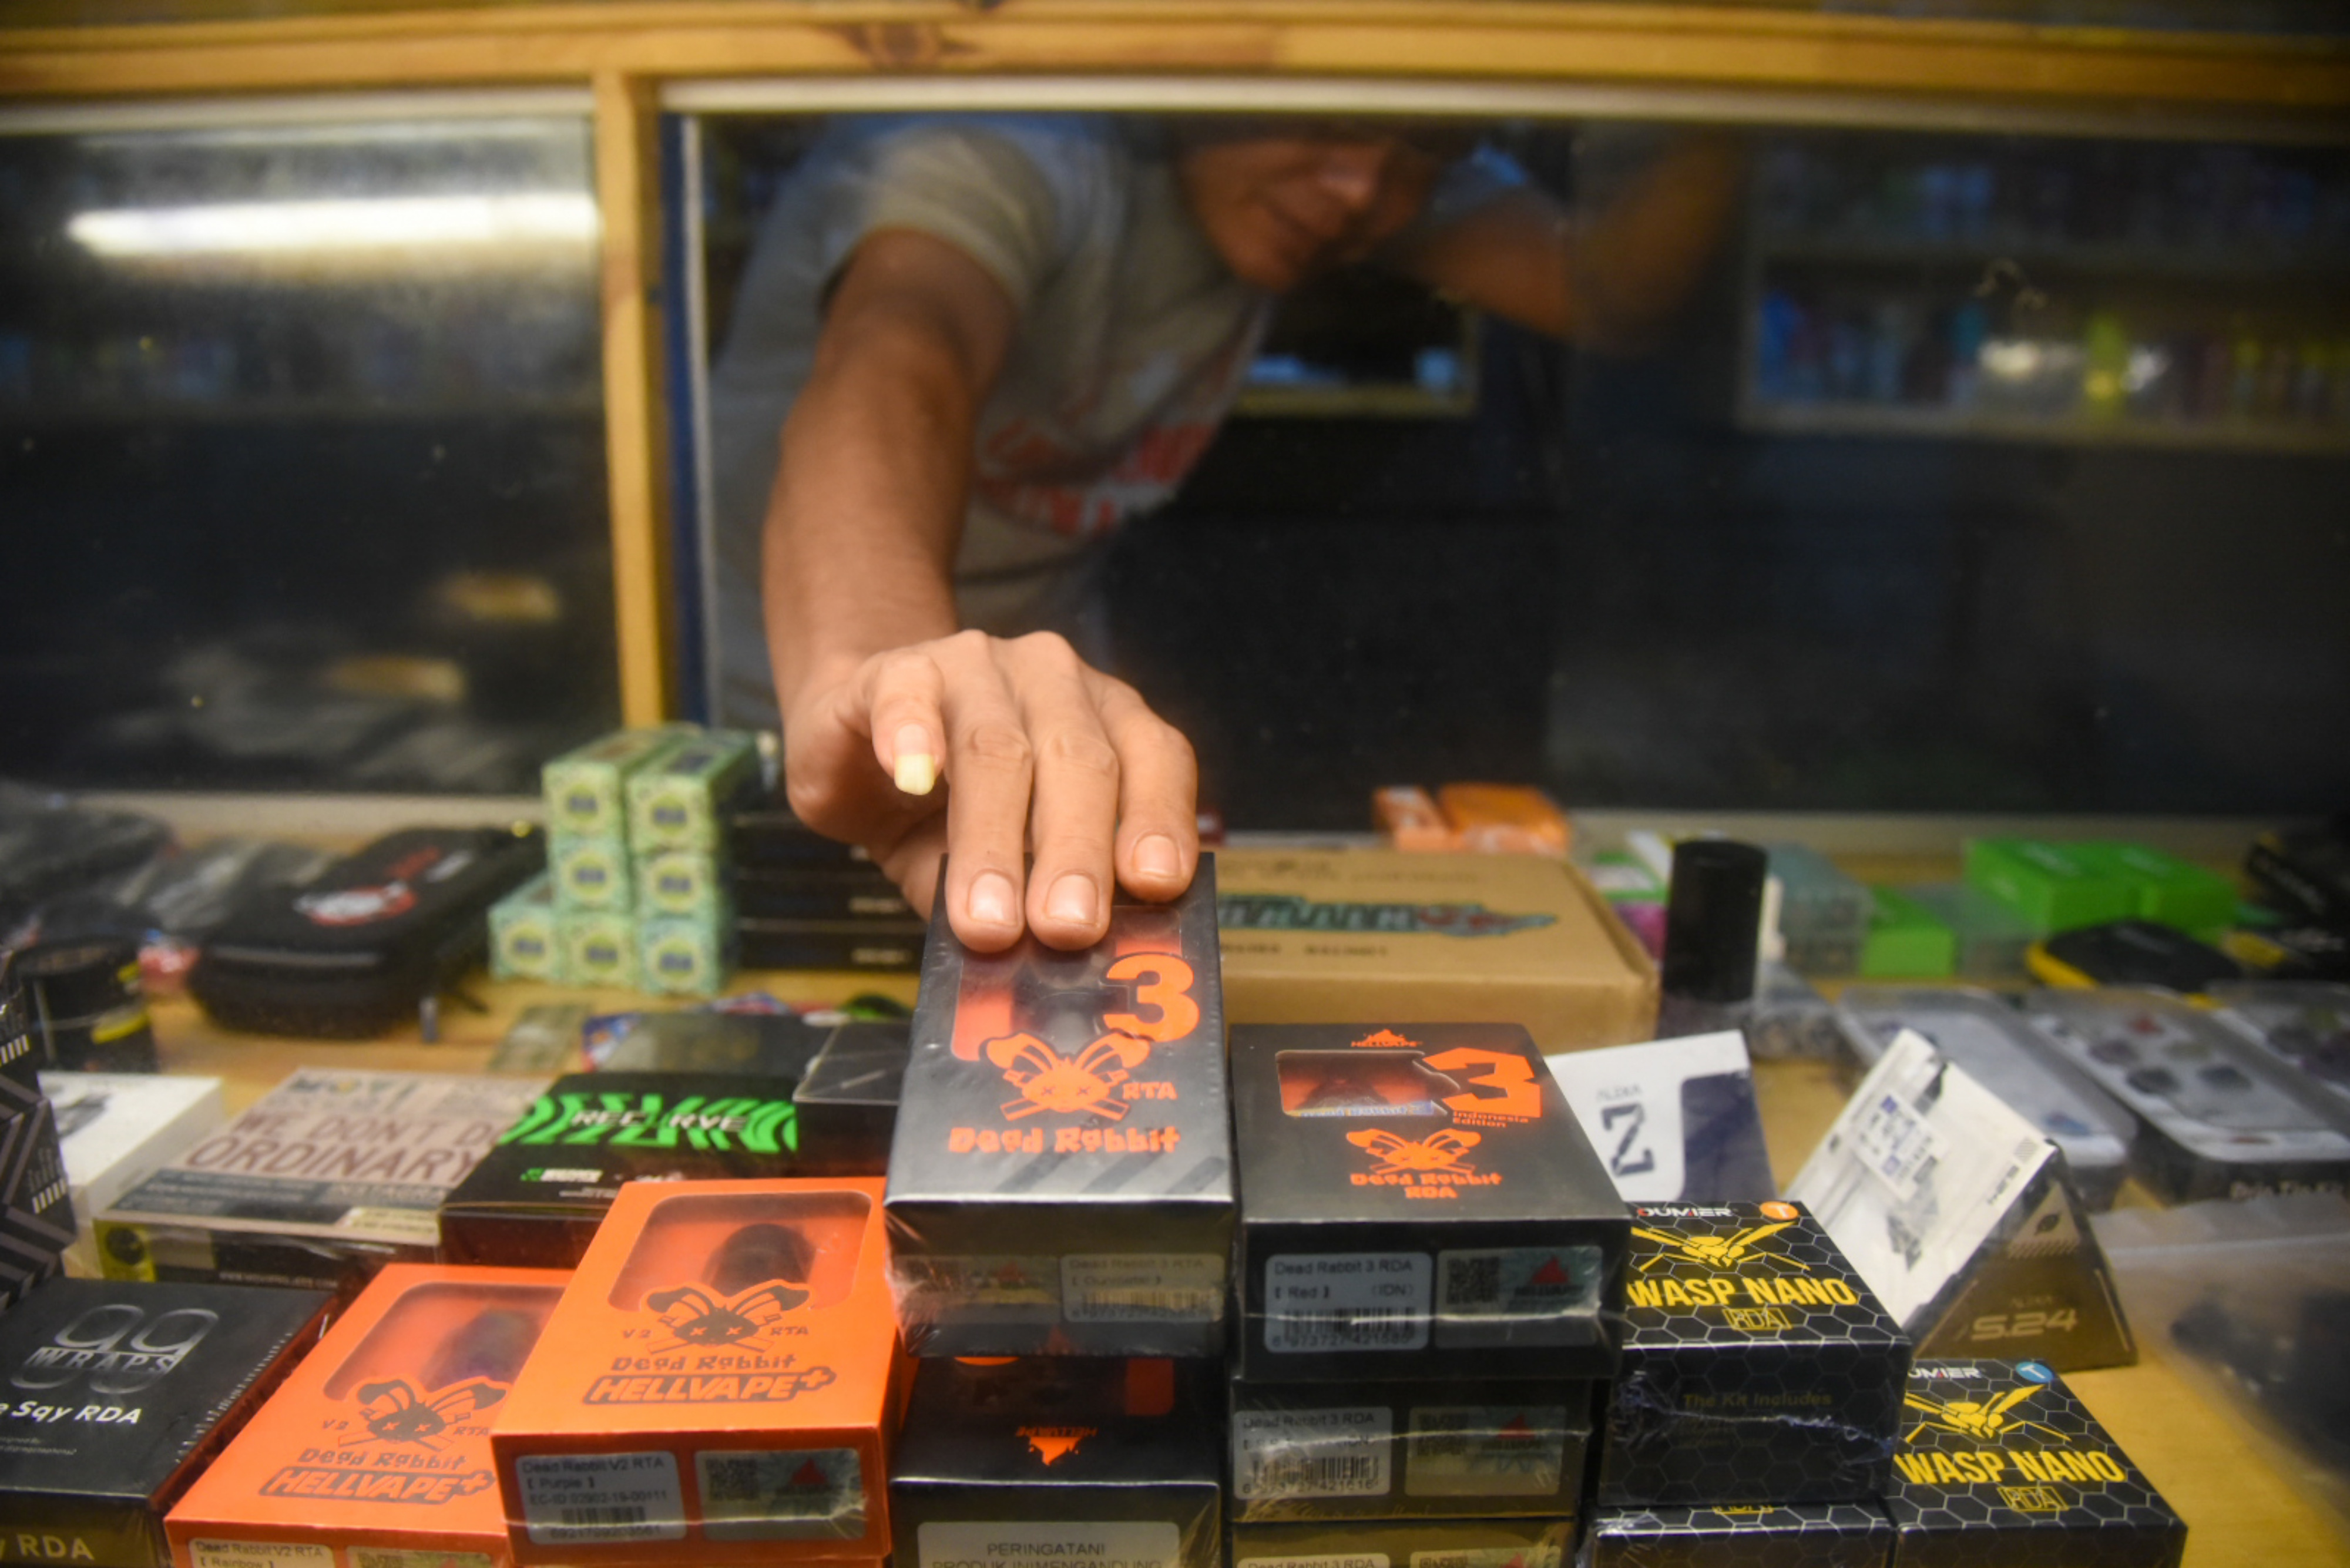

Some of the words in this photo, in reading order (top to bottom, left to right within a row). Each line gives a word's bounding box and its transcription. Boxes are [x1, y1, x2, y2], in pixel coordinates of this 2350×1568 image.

[1103, 951, 1200, 1043] 3
[1123, 1081, 1178, 1100] RTA
[1422, 1047, 1542, 1118] 3
[1452, 1111, 1530, 1123] Indonesia
[1452, 1118, 1507, 1129] Edition
[948, 1127, 1043, 1153] Dead
[1055, 1126, 1181, 1153] Rabbit
[1601, 1103, 1655, 1177] Z
[186, 1138, 479, 1182] ORDINARY
[1350, 1173, 1413, 1186] Dead
[1421, 1172, 1502, 1186] Rabbit
[1405, 1186, 1458, 1199] RDA
[1274, 1262, 1312, 1274] Dead
[1317, 1261, 1362, 1273] Rabbit
[1366, 1260, 1374, 1271] 3
[1379, 1260, 1413, 1272] RDA
[1627, 1278, 1735, 1307] WASP
[1742, 1277, 1861, 1305] NANO
[1730, 1309, 1786, 1329] RDA
[770, 1324, 808, 1336] RTA
[24, 1347, 176, 1374] WRAPS
[611, 1356, 686, 1371] Dead
[696, 1354, 796, 1370] Rabbit
[1683, 1394, 1719, 1409] The
[1723, 1392, 1748, 1406] Kit
[1754, 1391, 1832, 1406] Includes
[74, 1404, 143, 1424] RDA
[1243, 1416, 1279, 1428] Dead
[1331, 1414, 1338, 1425] 3
[1342, 1412, 1375, 1425] RDA
[453, 1425, 490, 1438] RTA
[298, 1448, 368, 1466] Dead
[376, 1451, 467, 1471] Rabbit
[522, 1460, 559, 1474] Dead
[609, 1459, 629, 1470] V2
[632, 1458, 664, 1470] RTA
[1895, 1452, 2005, 1485] WASP
[2010, 1451, 2127, 1483] NANO
[539, 1478, 582, 1490] Purple
[2005, 1488, 2057, 1509] RDA
[16, 1533, 95, 1560] RDA
[196, 1542, 230, 1552] Dead
[233, 1543, 273, 1555] Rabbit
[273, 1545, 292, 1556] V2
[294, 1545, 323, 1558] RTA
[211, 1559, 263, 1568] Rainbow
